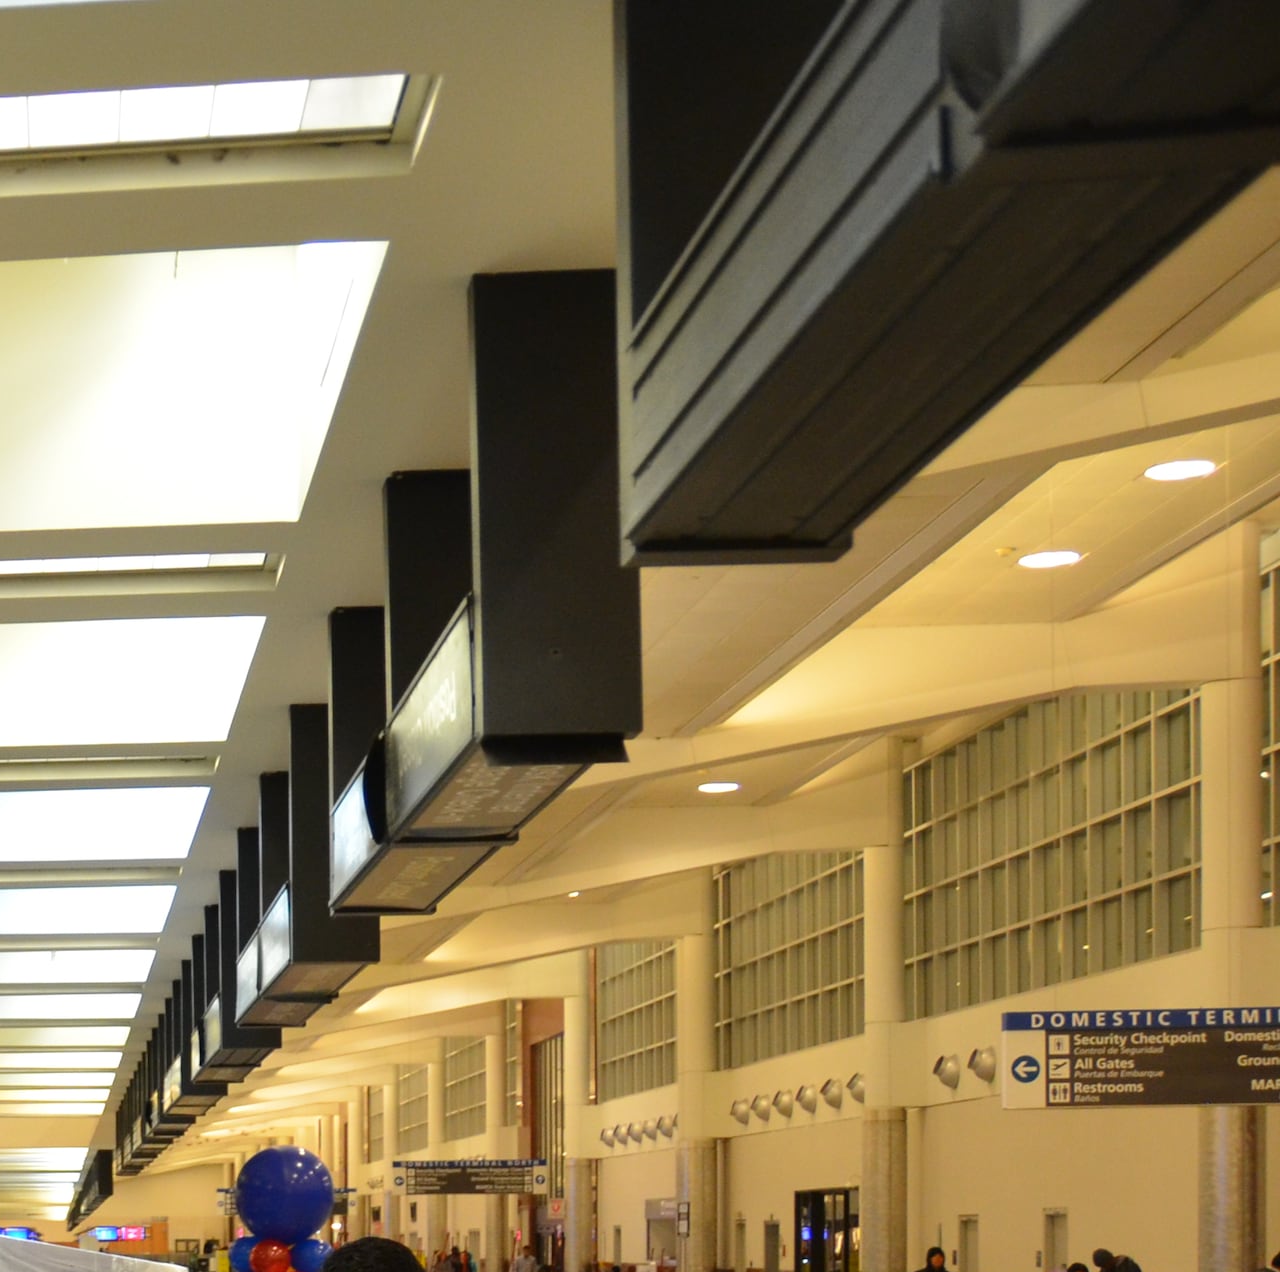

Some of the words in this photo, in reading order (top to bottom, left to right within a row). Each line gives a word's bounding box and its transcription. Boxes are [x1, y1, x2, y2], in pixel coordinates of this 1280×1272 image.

[1030, 1011, 1171, 1028] DOMESTIC
[1186, 1008, 1280, 1026] TERMI
[1073, 1033, 1127, 1047] Security
[1130, 1031, 1208, 1046] Checkpoint
[1074, 1057, 1093, 1069] All
[1096, 1058, 1135, 1069] Gates
[1073, 1082, 1144, 1093] Restrooms
